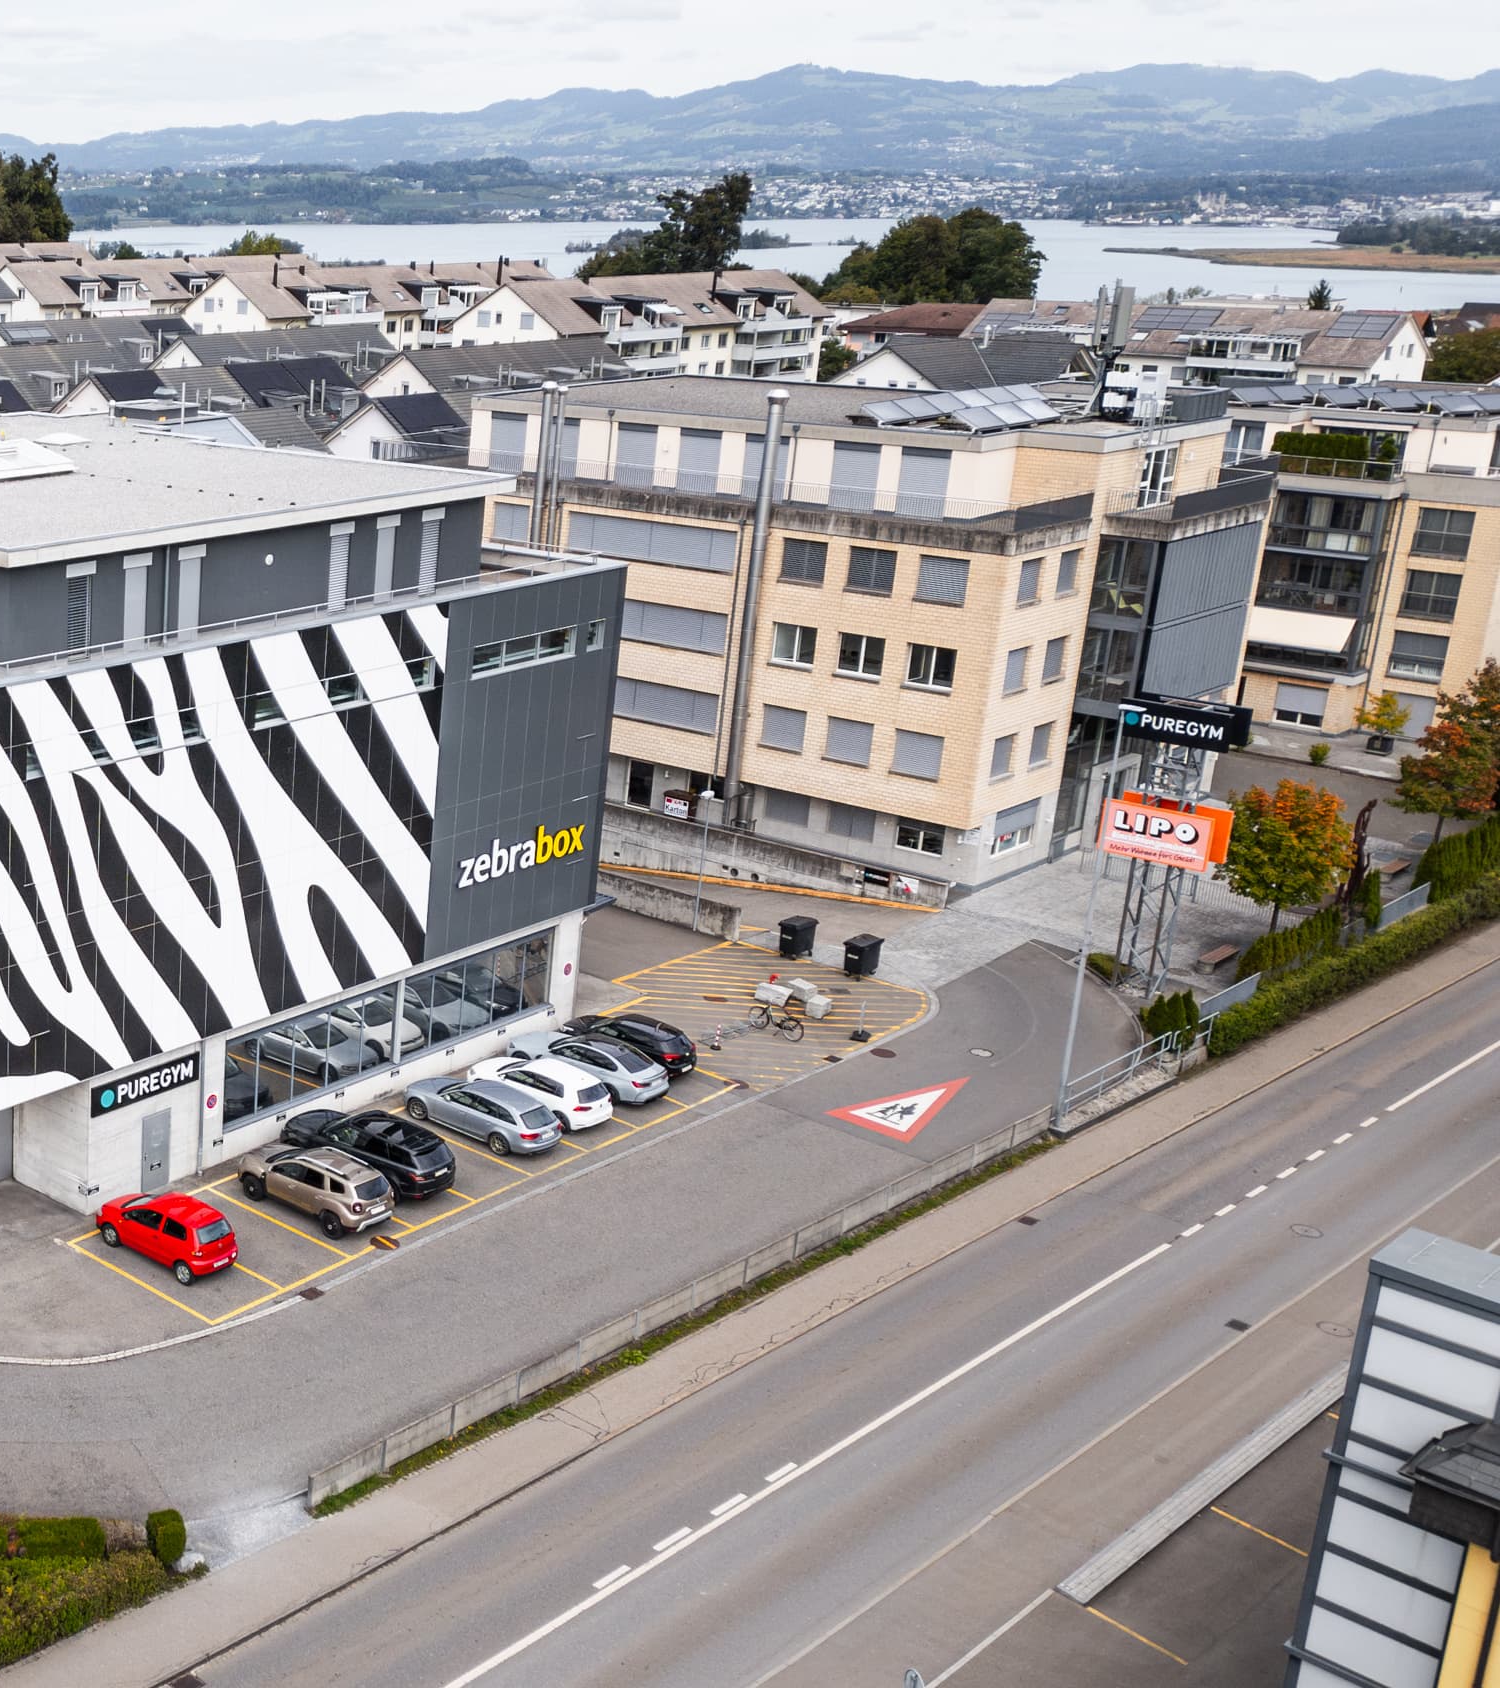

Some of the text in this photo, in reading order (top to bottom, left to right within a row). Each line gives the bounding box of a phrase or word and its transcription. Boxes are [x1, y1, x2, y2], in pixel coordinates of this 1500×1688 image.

[1140, 714, 1224, 741] PUREGYM
[1114, 809, 1200, 845] LIPO
[457, 823, 585, 889] zebrabox
[117, 1059, 194, 1104] PUREGYM
